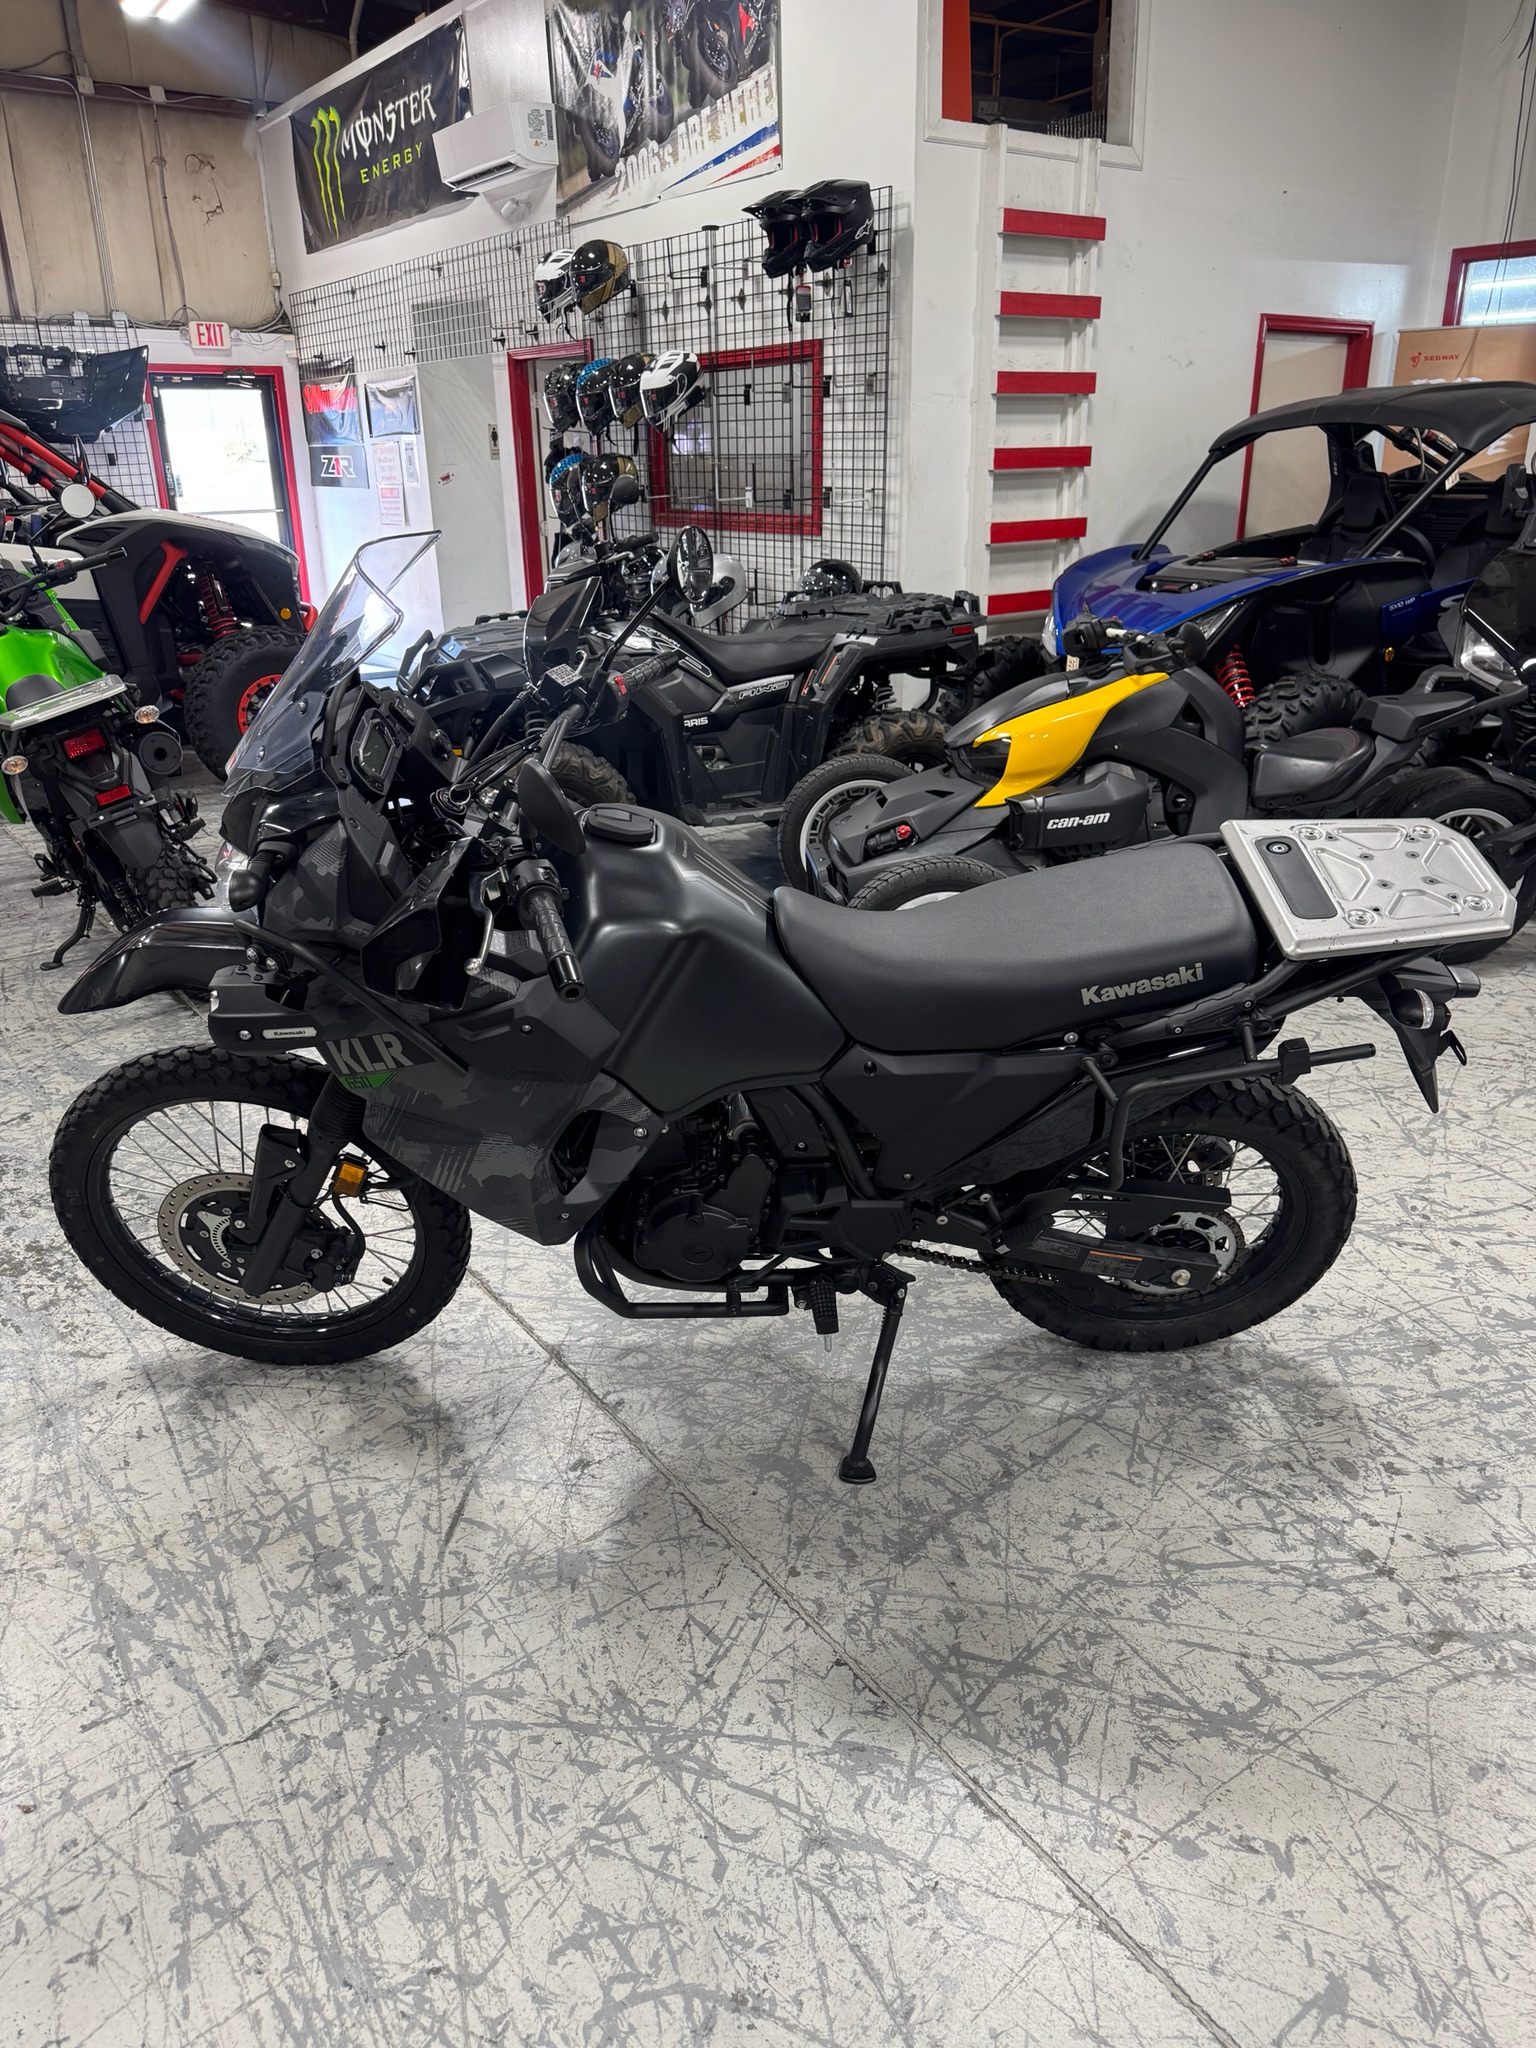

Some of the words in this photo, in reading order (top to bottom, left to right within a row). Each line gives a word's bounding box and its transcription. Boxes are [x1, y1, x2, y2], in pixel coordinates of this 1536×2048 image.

[341, 82, 437, 160] MONSTER
[360, 142, 422, 184] ENERGY
[196, 323, 224, 346] EXIT
[1423, 354, 1460, 362] SEGWAY
[1080, 962, 1204, 1006] Kawasaki
[273, 1029, 306, 1037] Kawasaki
[325, 1033, 415, 1075] KLR
[344, 1075, 373, 1090] 650
